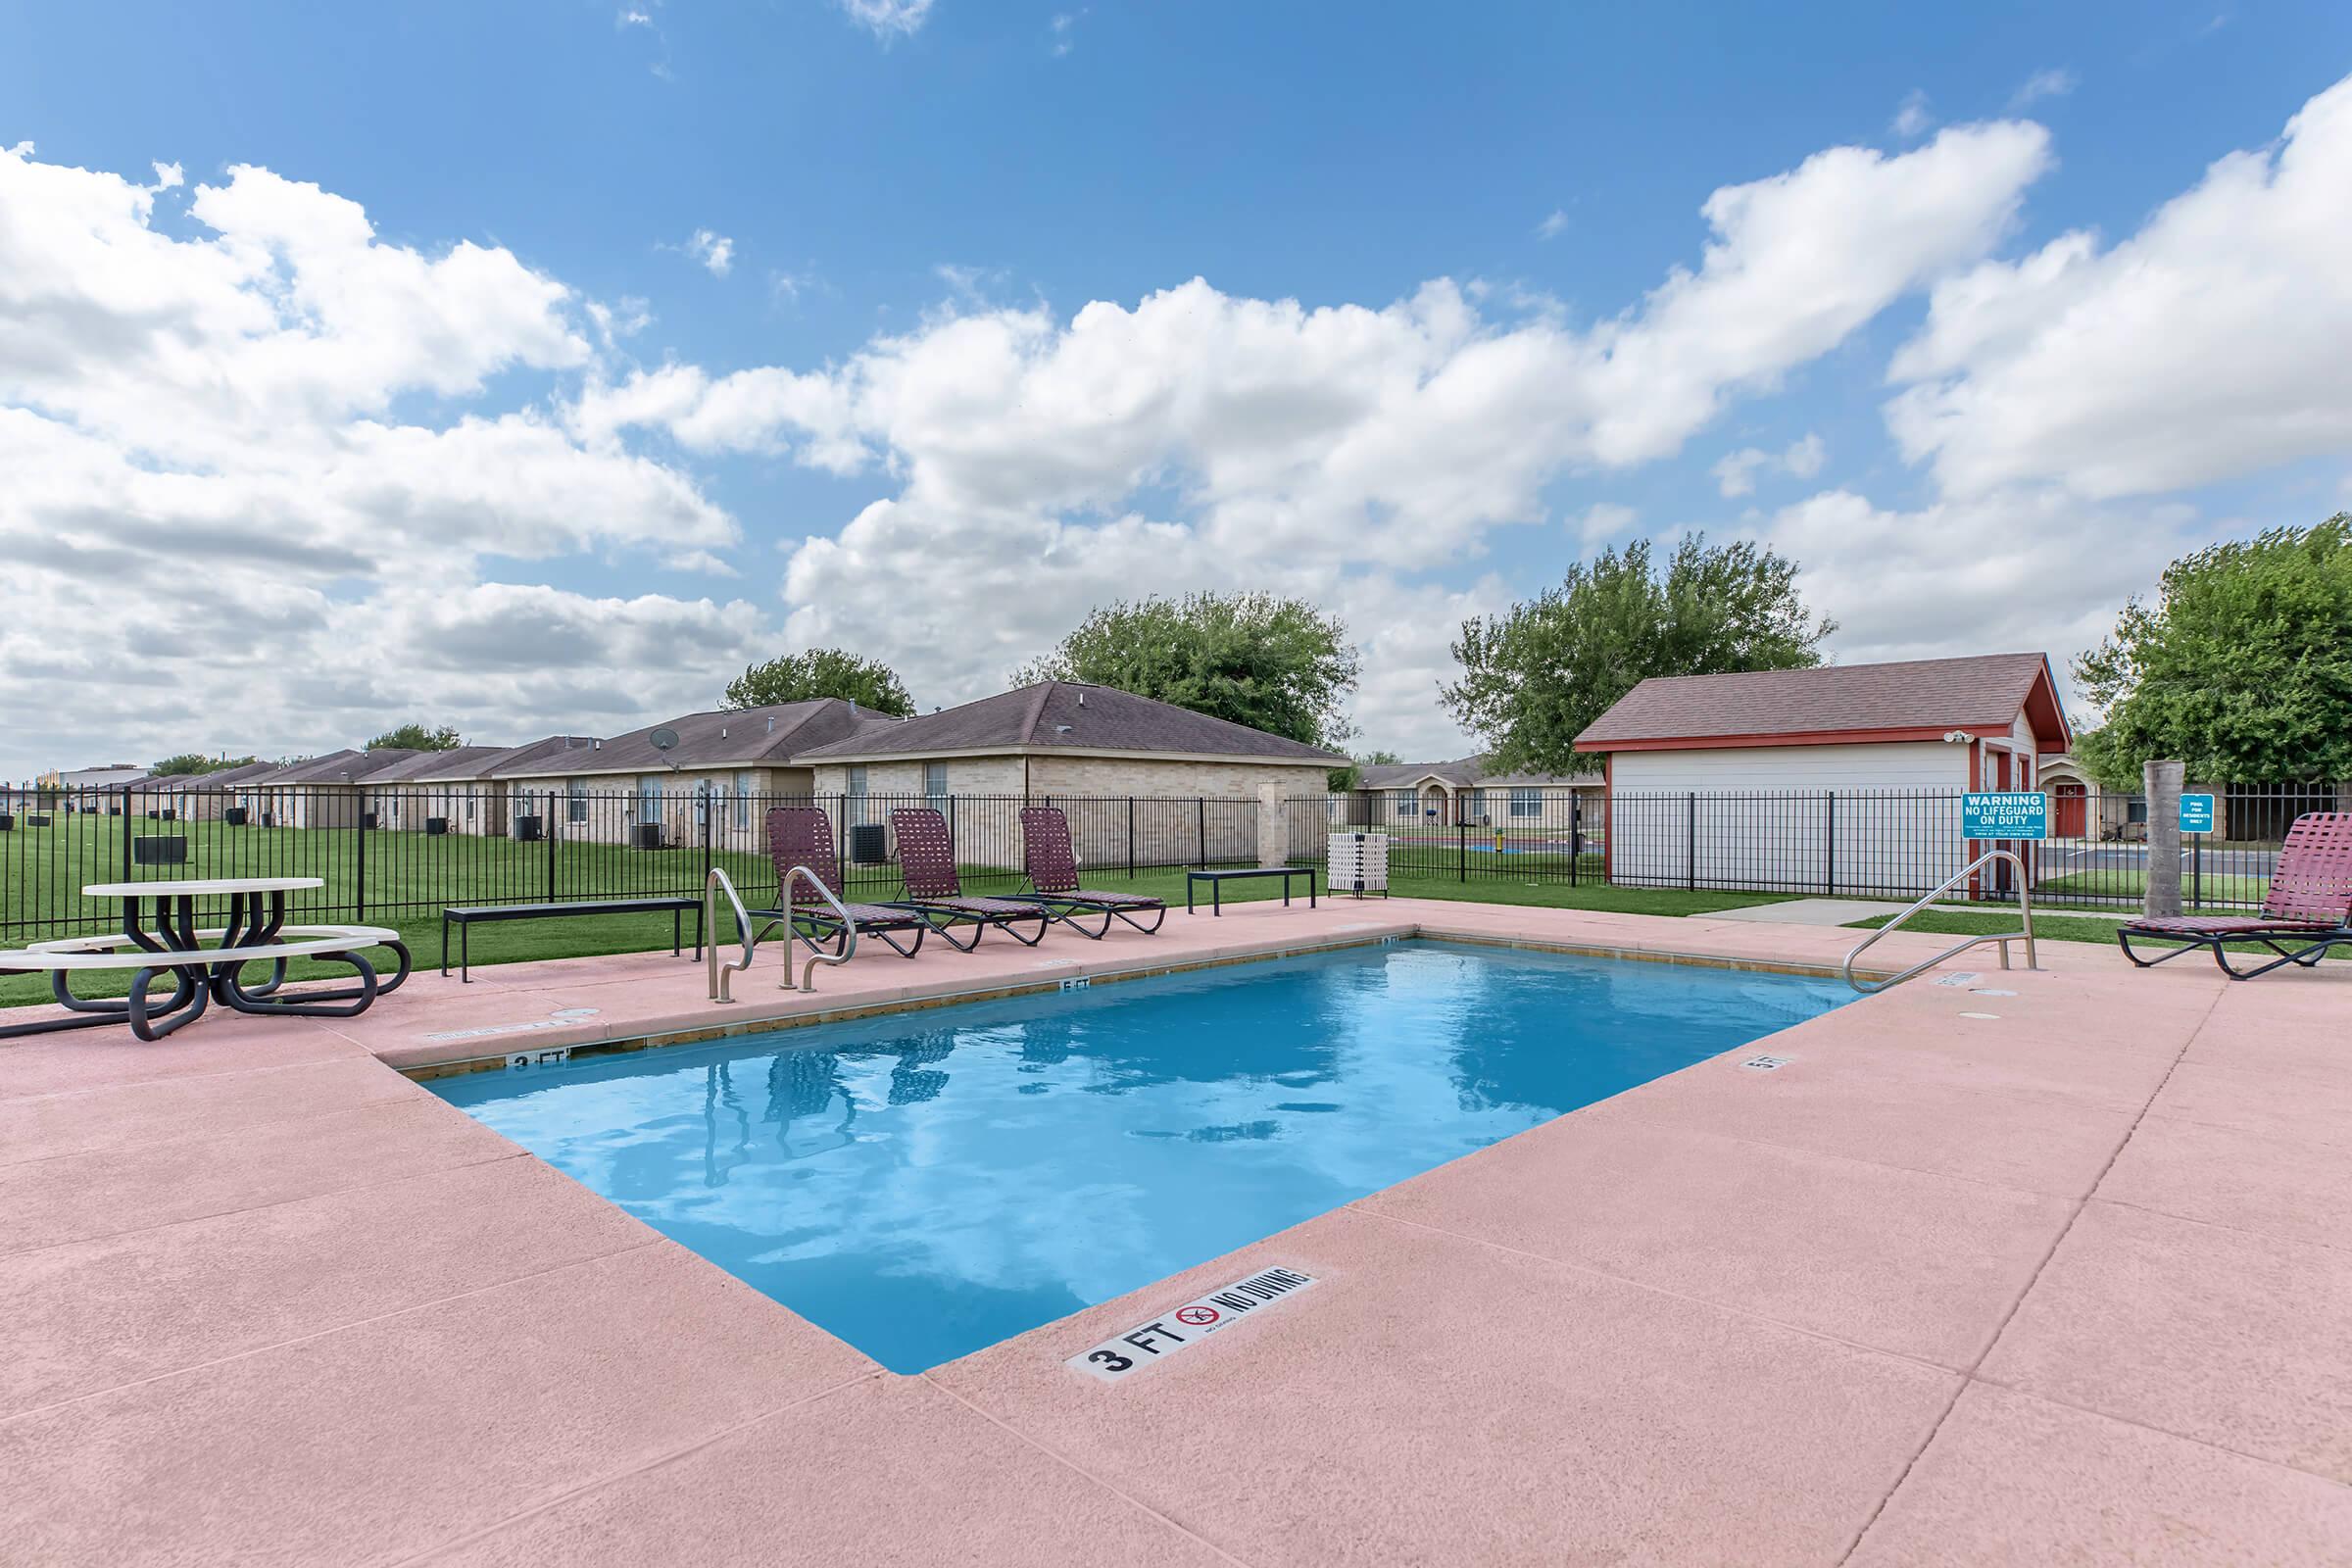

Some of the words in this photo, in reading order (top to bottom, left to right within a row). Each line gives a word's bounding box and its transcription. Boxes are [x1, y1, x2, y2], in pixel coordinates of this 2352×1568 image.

[1967, 795, 2041, 806] WARNING
[1965, 807, 1981, 815] NO
[1983, 807, 2044, 815] LIFEGUARD
[1980, 816, 1995, 825] ON
[1998, 816, 2028, 825] DUTY
[1088, 1349, 1134, 1372] 3
[1122, 1322, 1186, 1355] FT
[1209, 1292, 1258, 1313] NO
[1236, 1268, 1310, 1301] DIVING
